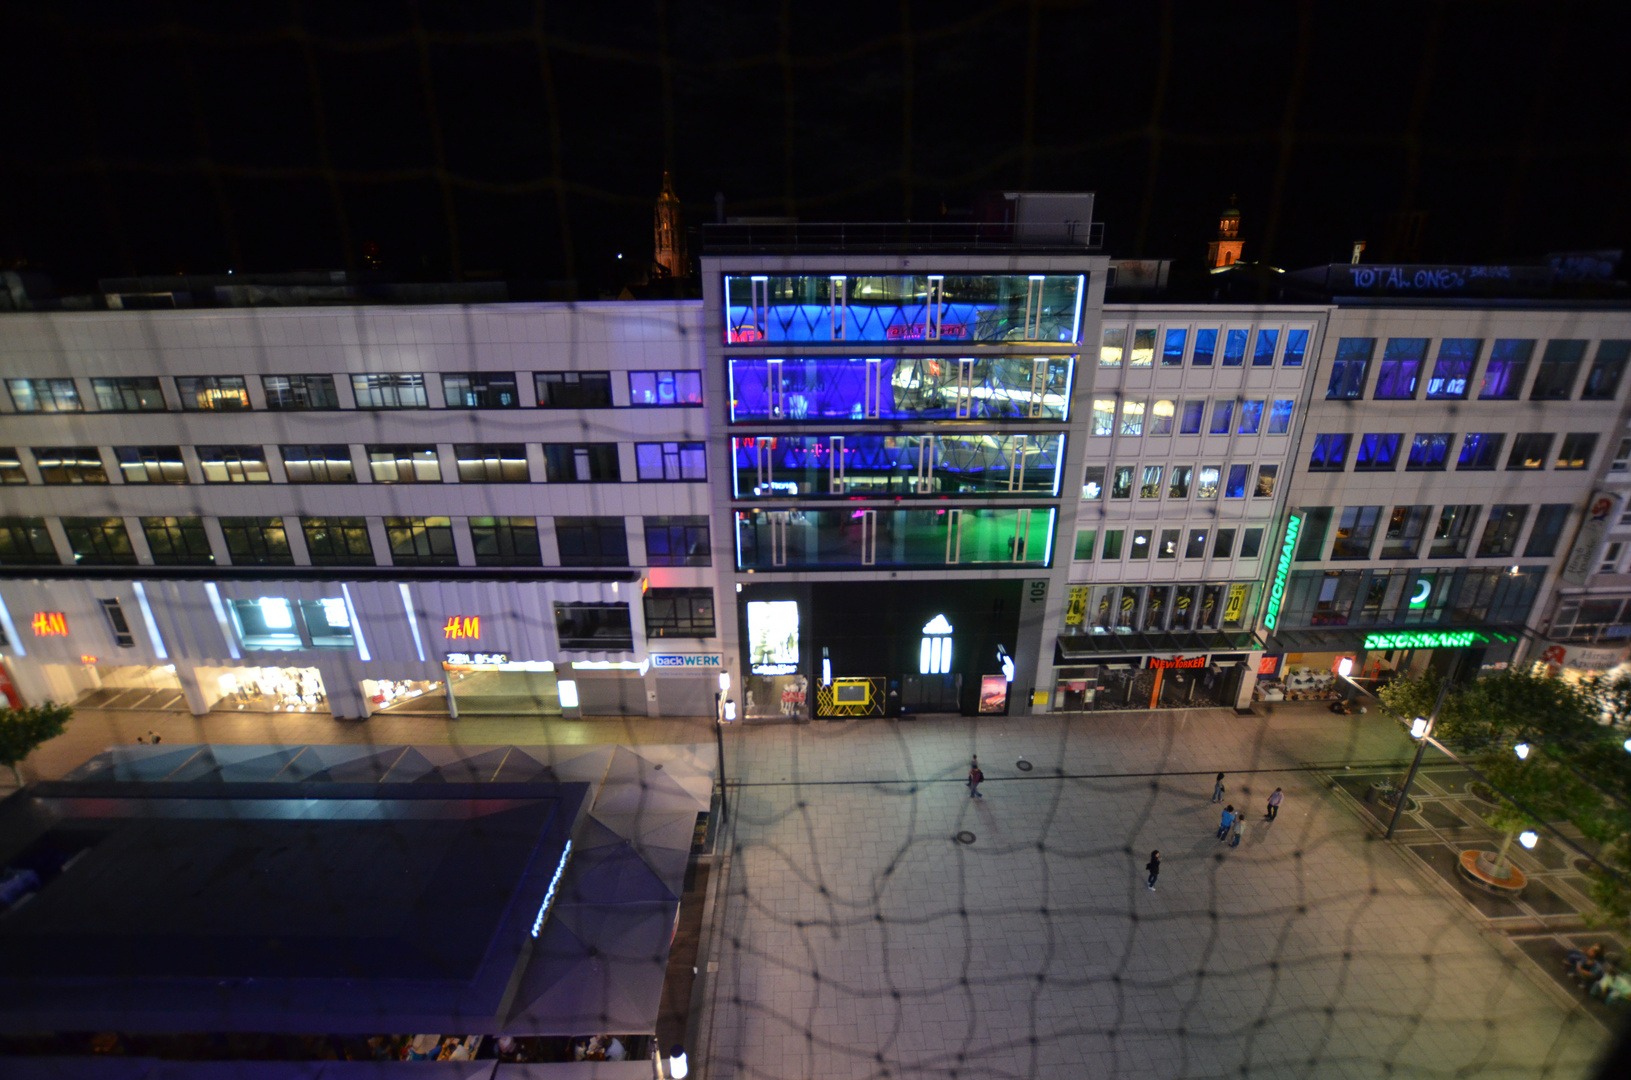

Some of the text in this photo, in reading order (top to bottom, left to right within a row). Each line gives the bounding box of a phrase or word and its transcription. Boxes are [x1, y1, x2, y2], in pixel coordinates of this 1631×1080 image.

[1349, 266, 1411, 288] TOTAL
[1264, 515, 1301, 630] DEICHMANN
[1030, 581, 1045, 603] 105
[31, 612, 69, 637] H&M
[443, 615, 480, 640] H&M
[1364, 632, 1474, 649] DEICHMANN
